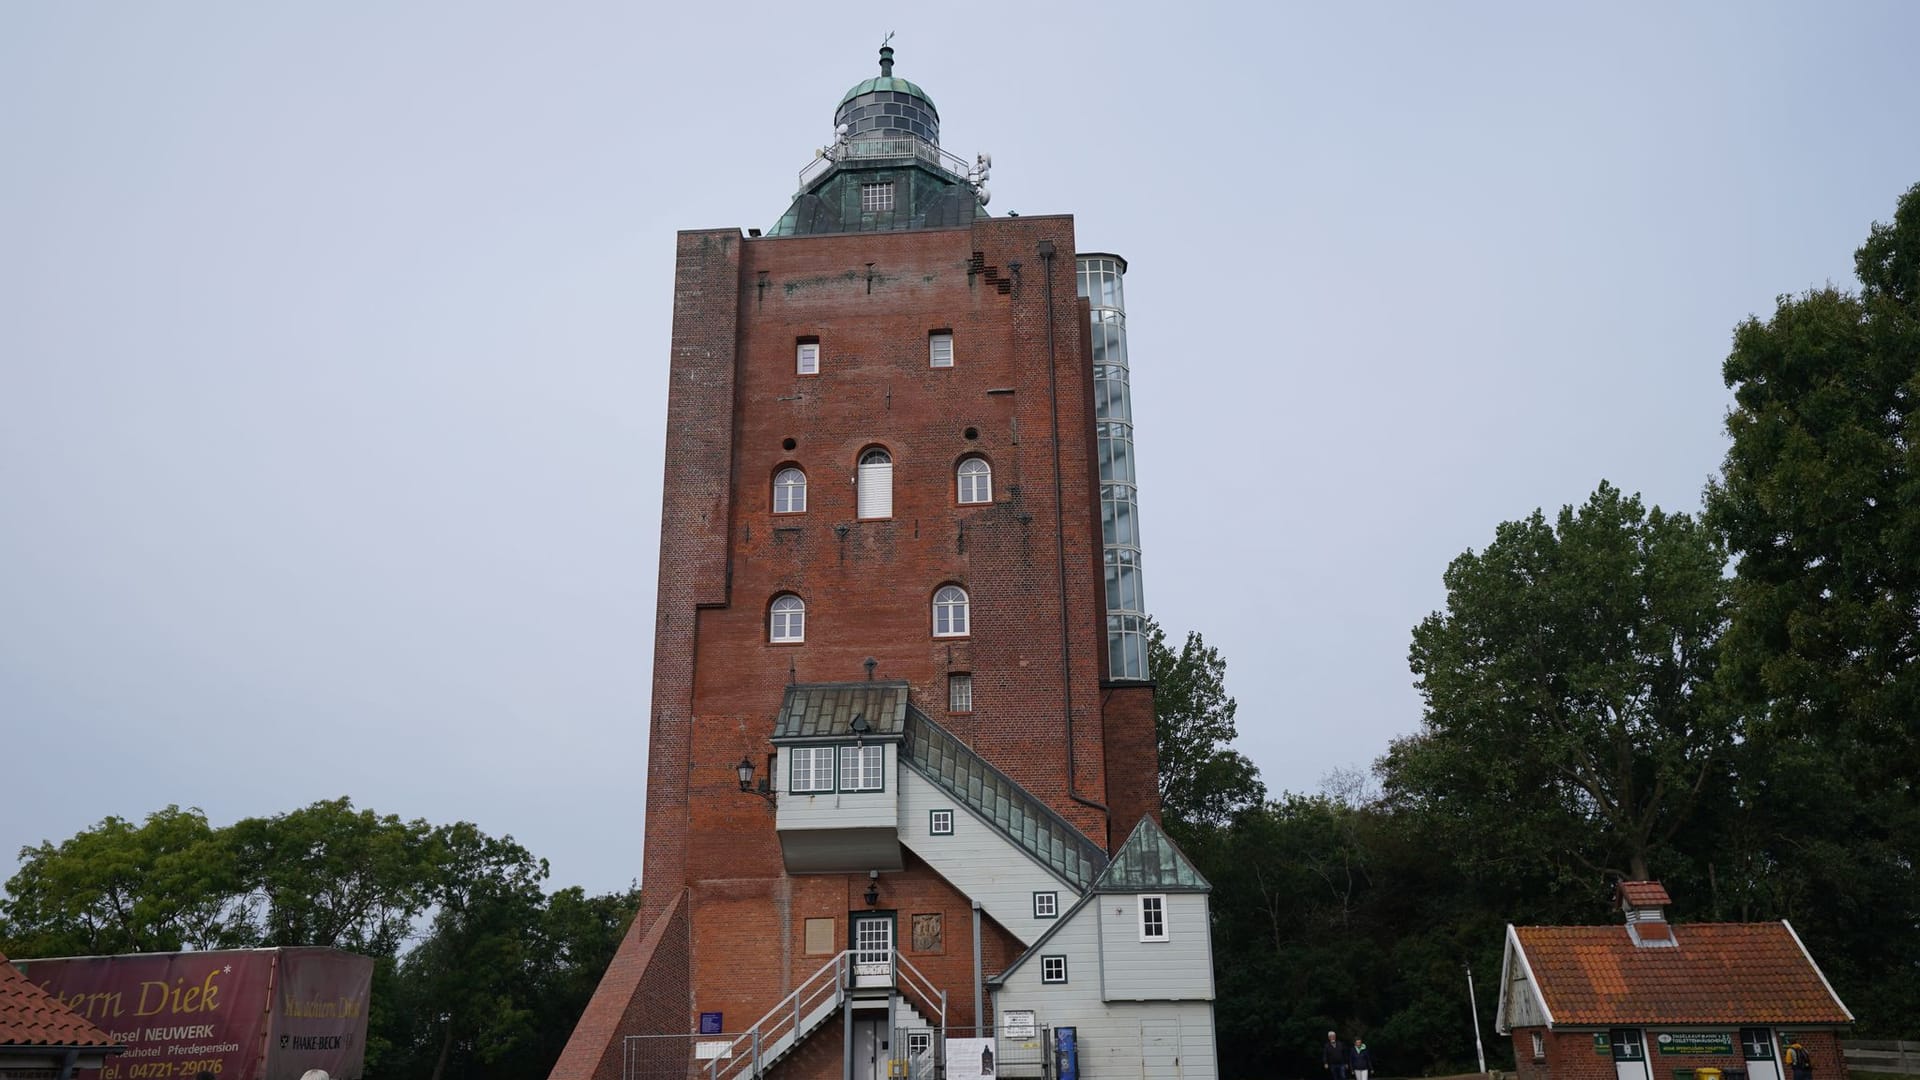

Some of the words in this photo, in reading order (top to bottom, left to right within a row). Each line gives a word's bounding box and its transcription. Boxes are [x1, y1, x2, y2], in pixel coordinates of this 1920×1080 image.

[133, 969, 220, 1016] Diek
[110, 1028, 140, 1042] Insel
[144, 1024, 215, 1041] NEUWERK
[115, 1046, 161, 1058] euhotel
[167, 1041, 239, 1056] Pferdepension
[129, 1059, 223, 1079] 04721-29076
